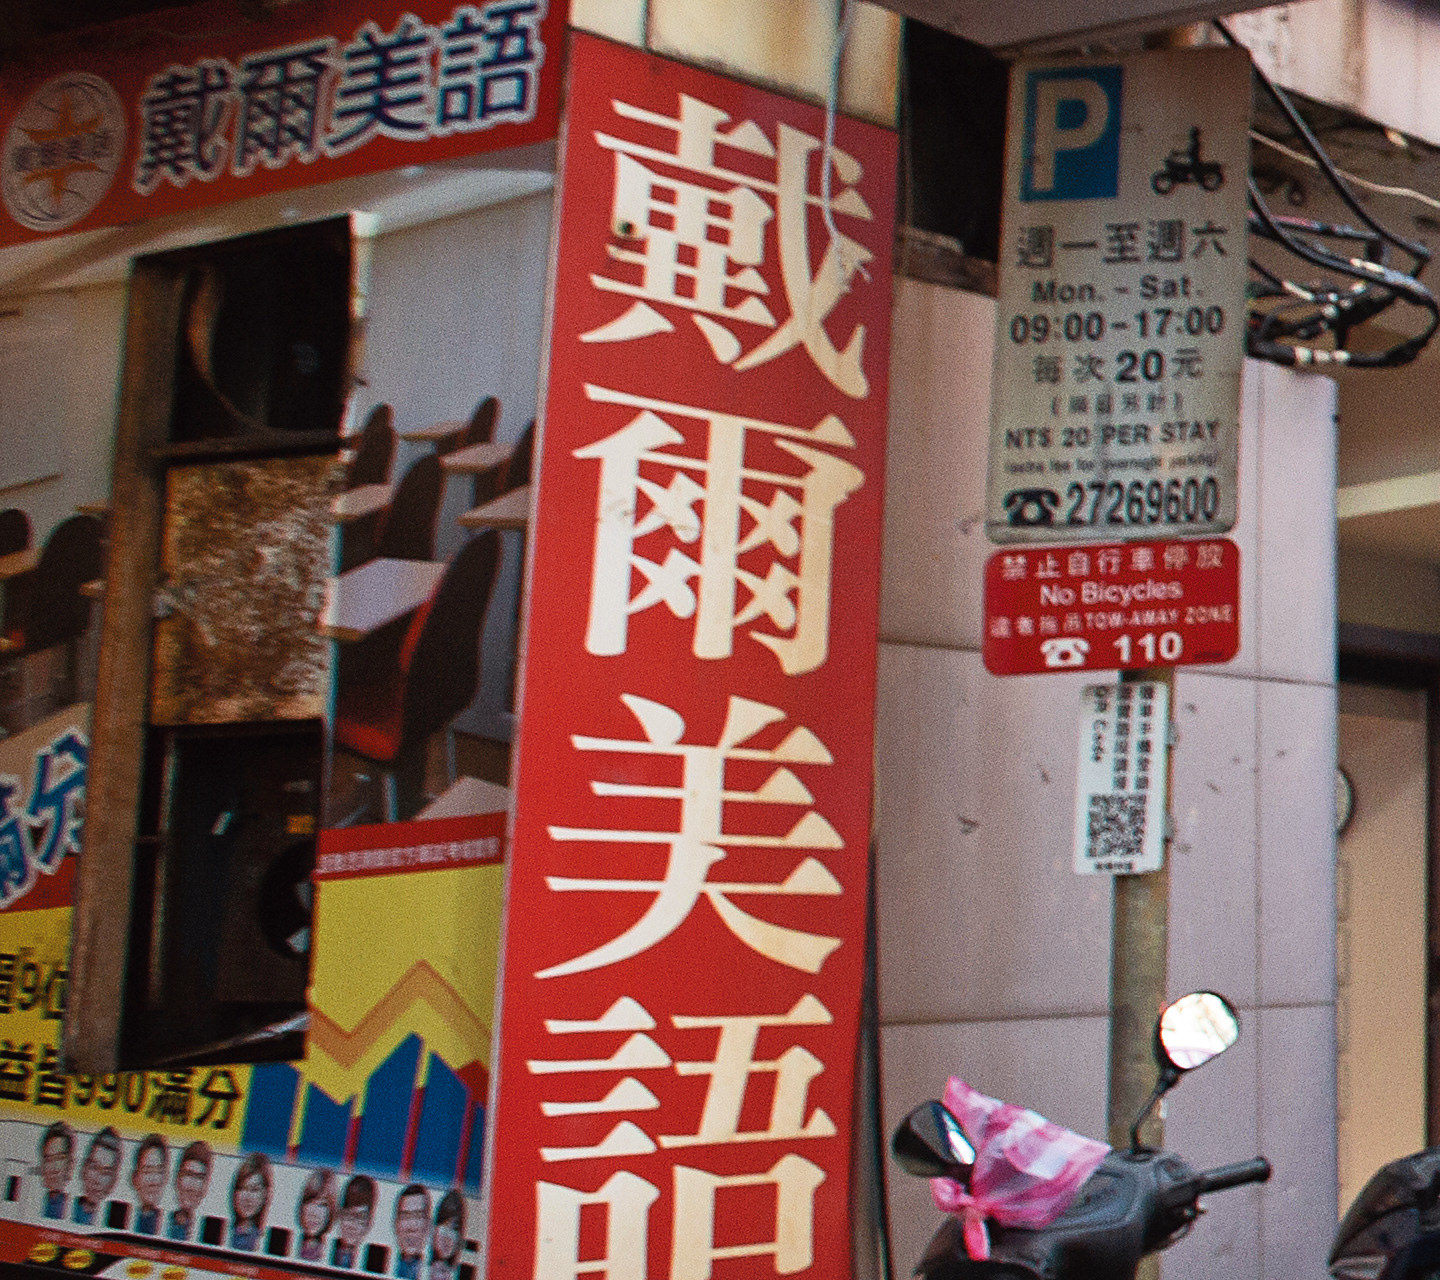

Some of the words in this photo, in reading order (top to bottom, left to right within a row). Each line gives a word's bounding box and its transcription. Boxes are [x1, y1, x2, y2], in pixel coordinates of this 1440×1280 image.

[1032, 75, 1110, 192] P
[1015, 219, 1228, 269] 週一至週六
[1061, 425, 1091, 448] 20
[1101, 422, 1151, 446] PER
[1158, 419, 1220, 443] STAY
[1066, 475, 1221, 524] 27269600
[1040, 583, 1077, 606] No
[1082, 580, 1184, 607] Bicycles
[1113, 631, 1184, 664] 110
